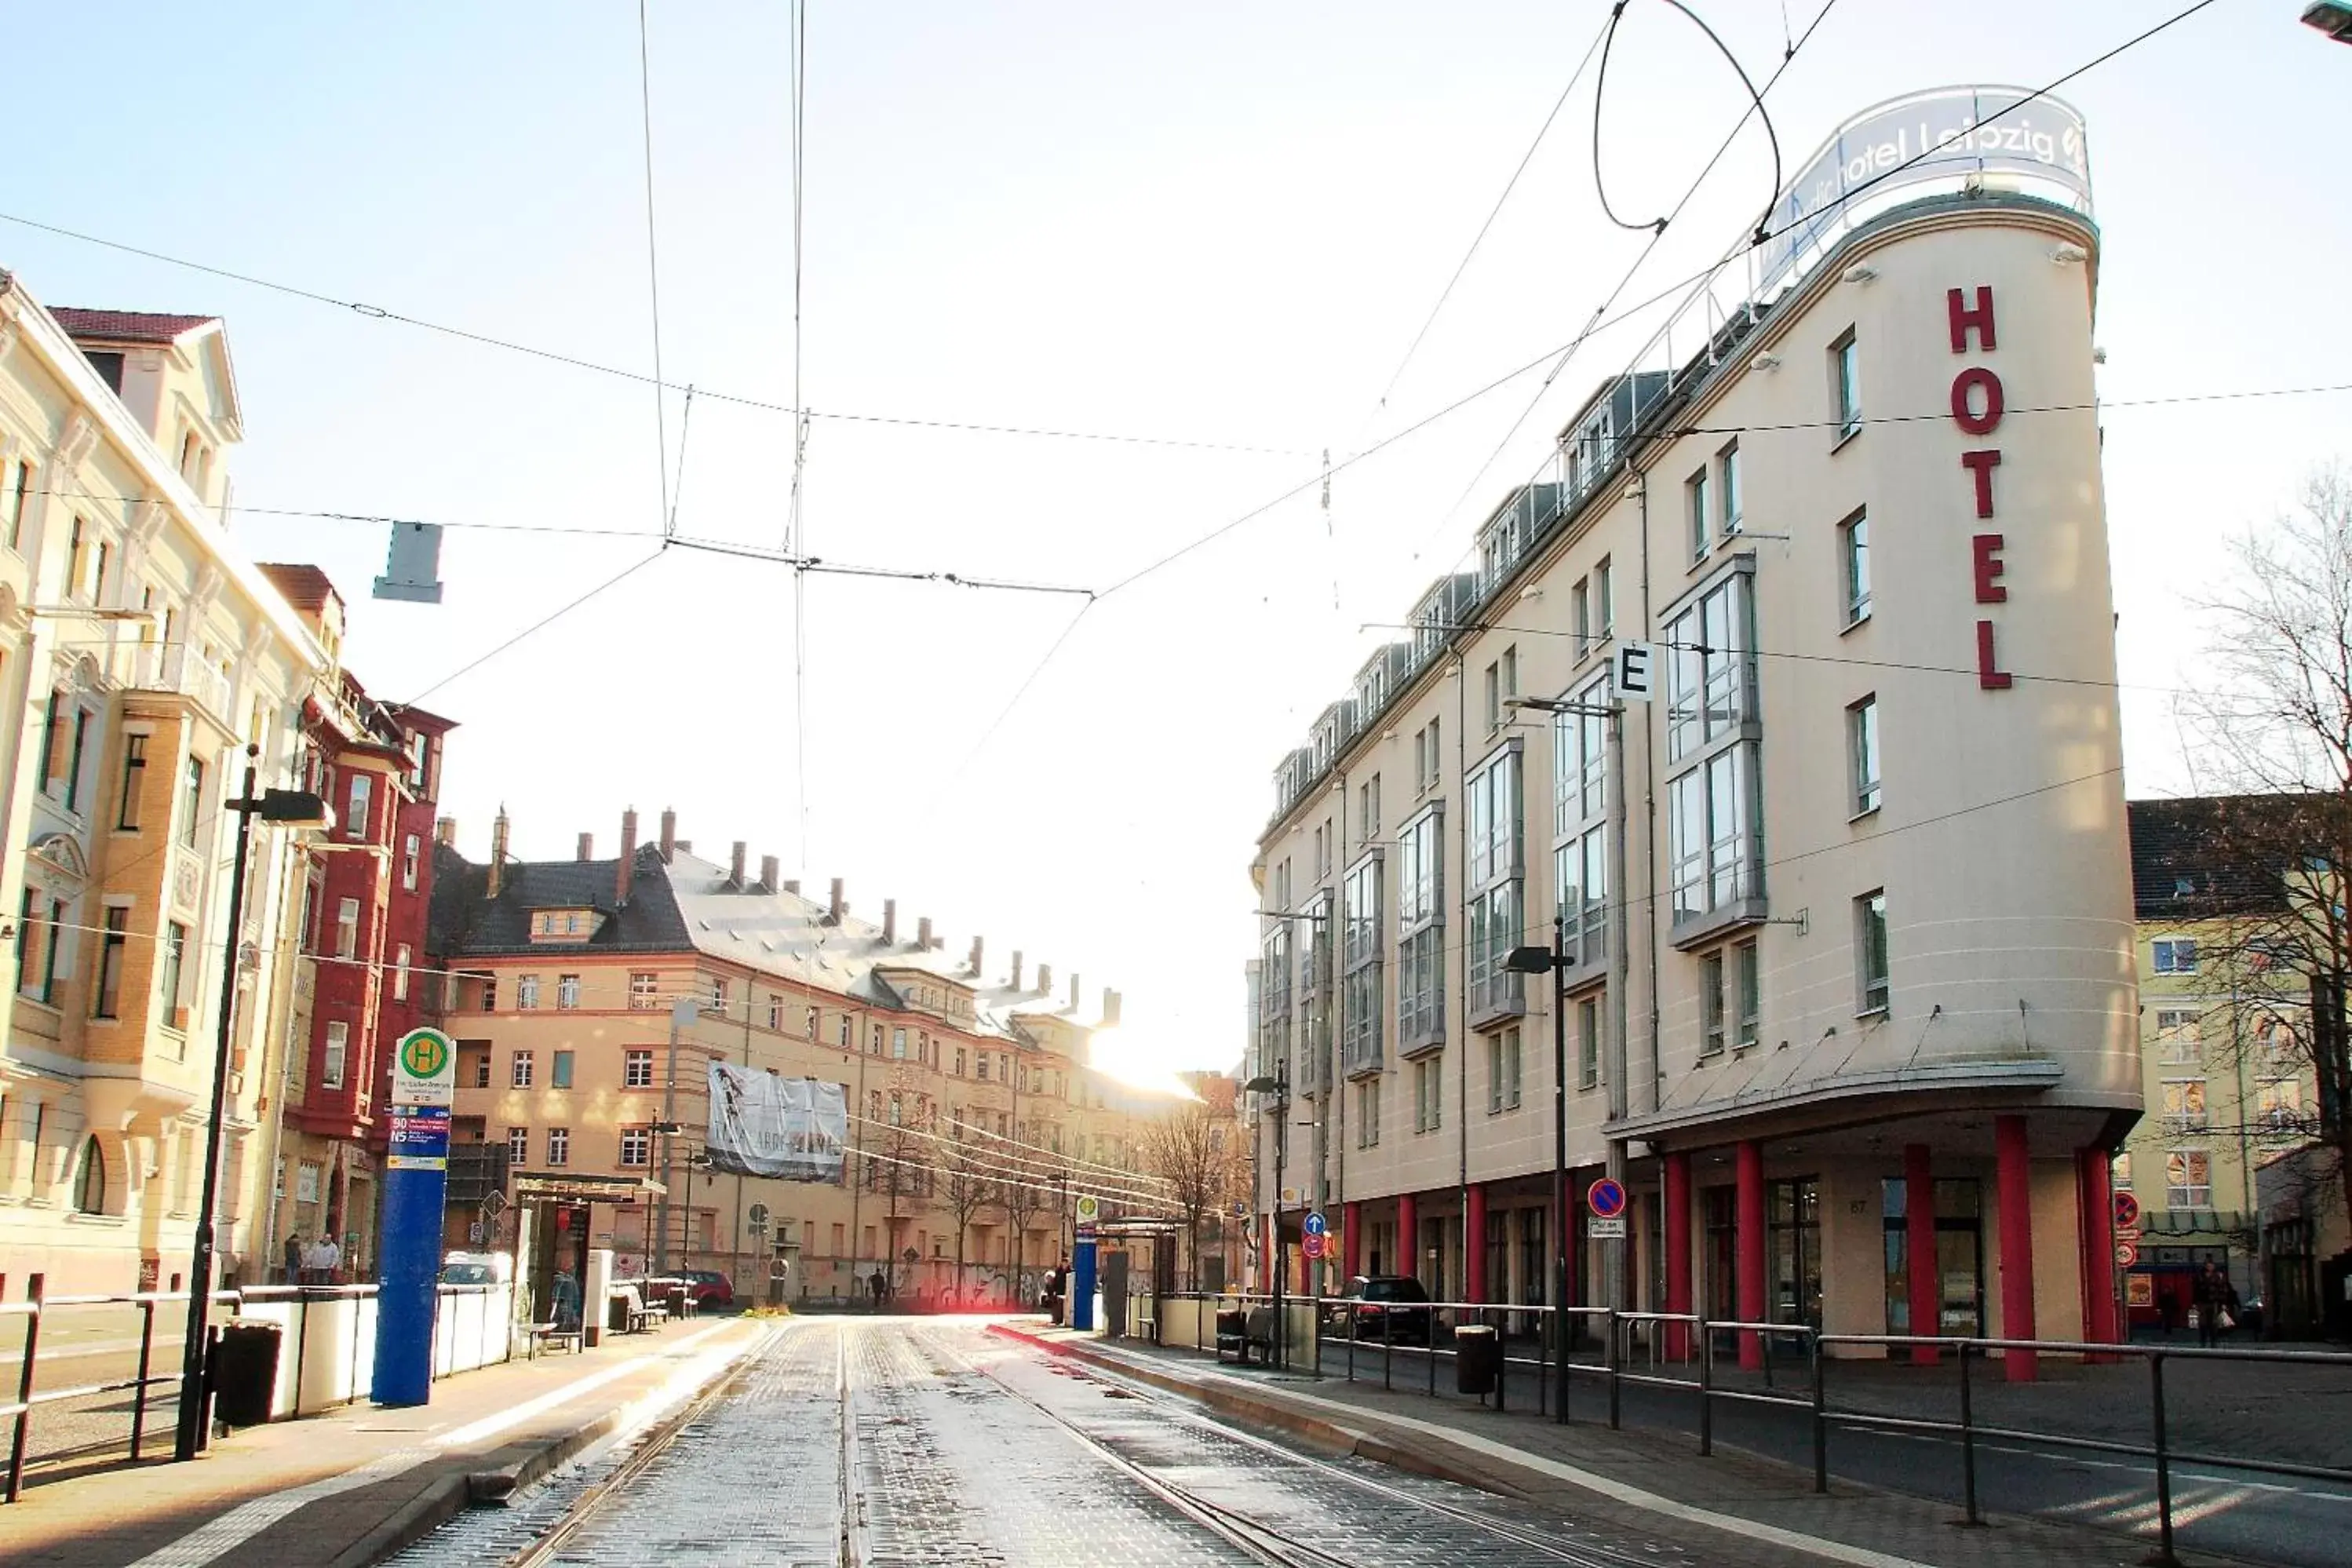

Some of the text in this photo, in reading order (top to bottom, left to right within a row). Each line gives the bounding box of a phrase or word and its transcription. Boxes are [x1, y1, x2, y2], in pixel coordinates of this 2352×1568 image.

[1920, 117, 2054, 162] Leipzig
[1946, 286, 2012, 690] HOTEL
[1621, 647, 1647, 692] E
[414, 1041, 434, 1069] H
[392, 1118, 407, 1129] 90
